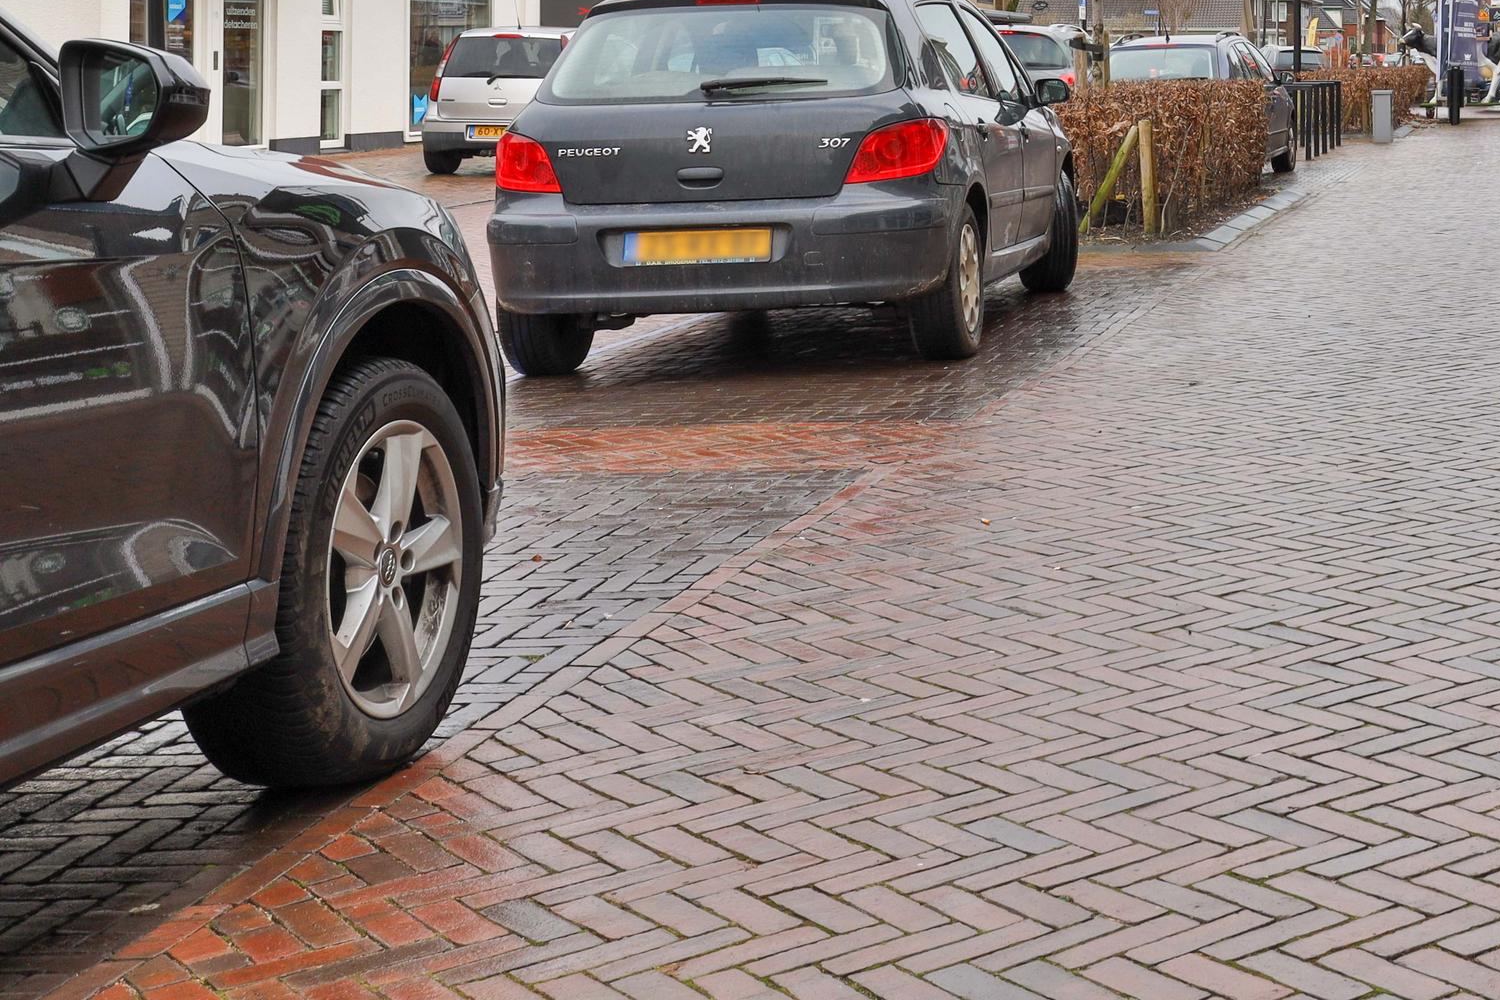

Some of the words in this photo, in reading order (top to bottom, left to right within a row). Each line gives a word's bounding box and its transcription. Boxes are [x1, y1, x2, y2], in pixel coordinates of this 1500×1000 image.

[226, 7, 256, 16] uitzenden
[224, 20, 258, 29] detacheren
[818, 137, 852, 149] 307
[558, 147, 621, 157] PEUGEOT
